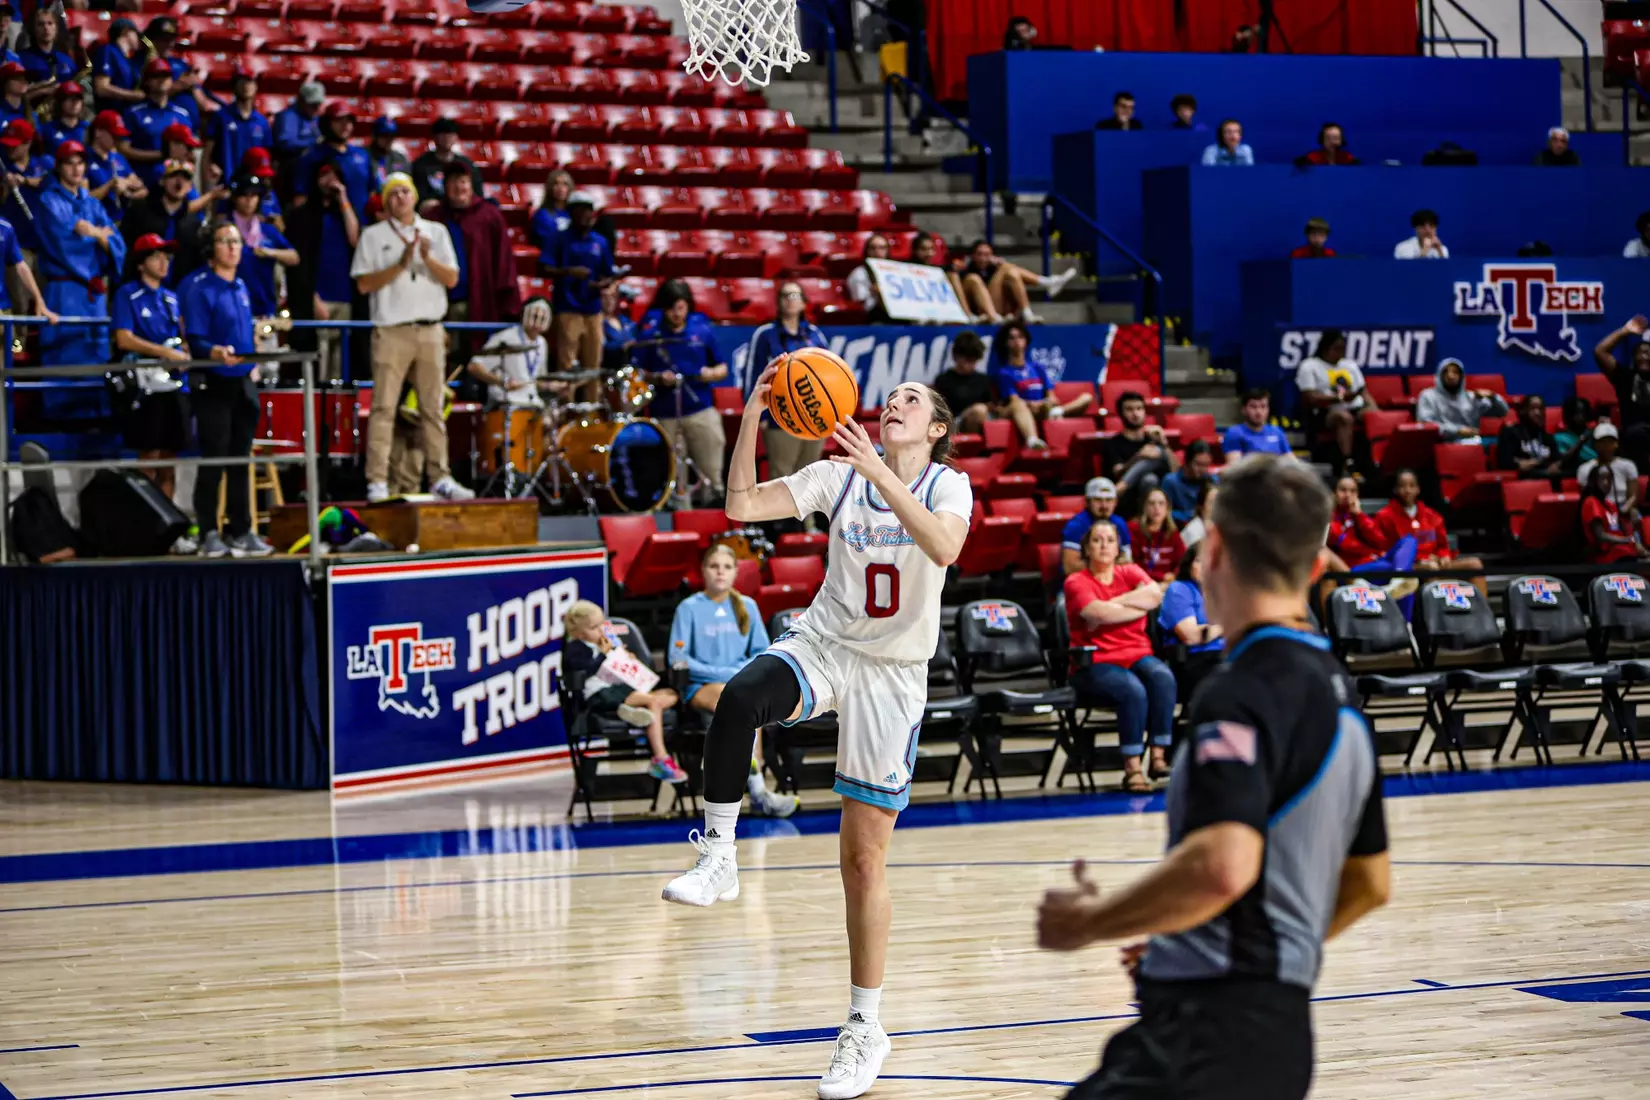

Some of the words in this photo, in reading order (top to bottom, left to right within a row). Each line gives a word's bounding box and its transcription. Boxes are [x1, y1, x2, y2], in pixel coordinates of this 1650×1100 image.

[1279, 330, 1434, 369] STDENT
[795, 374, 828, 432] Wilson
[838, 521, 871, 553] Lady
[865, 562, 900, 618] 0
